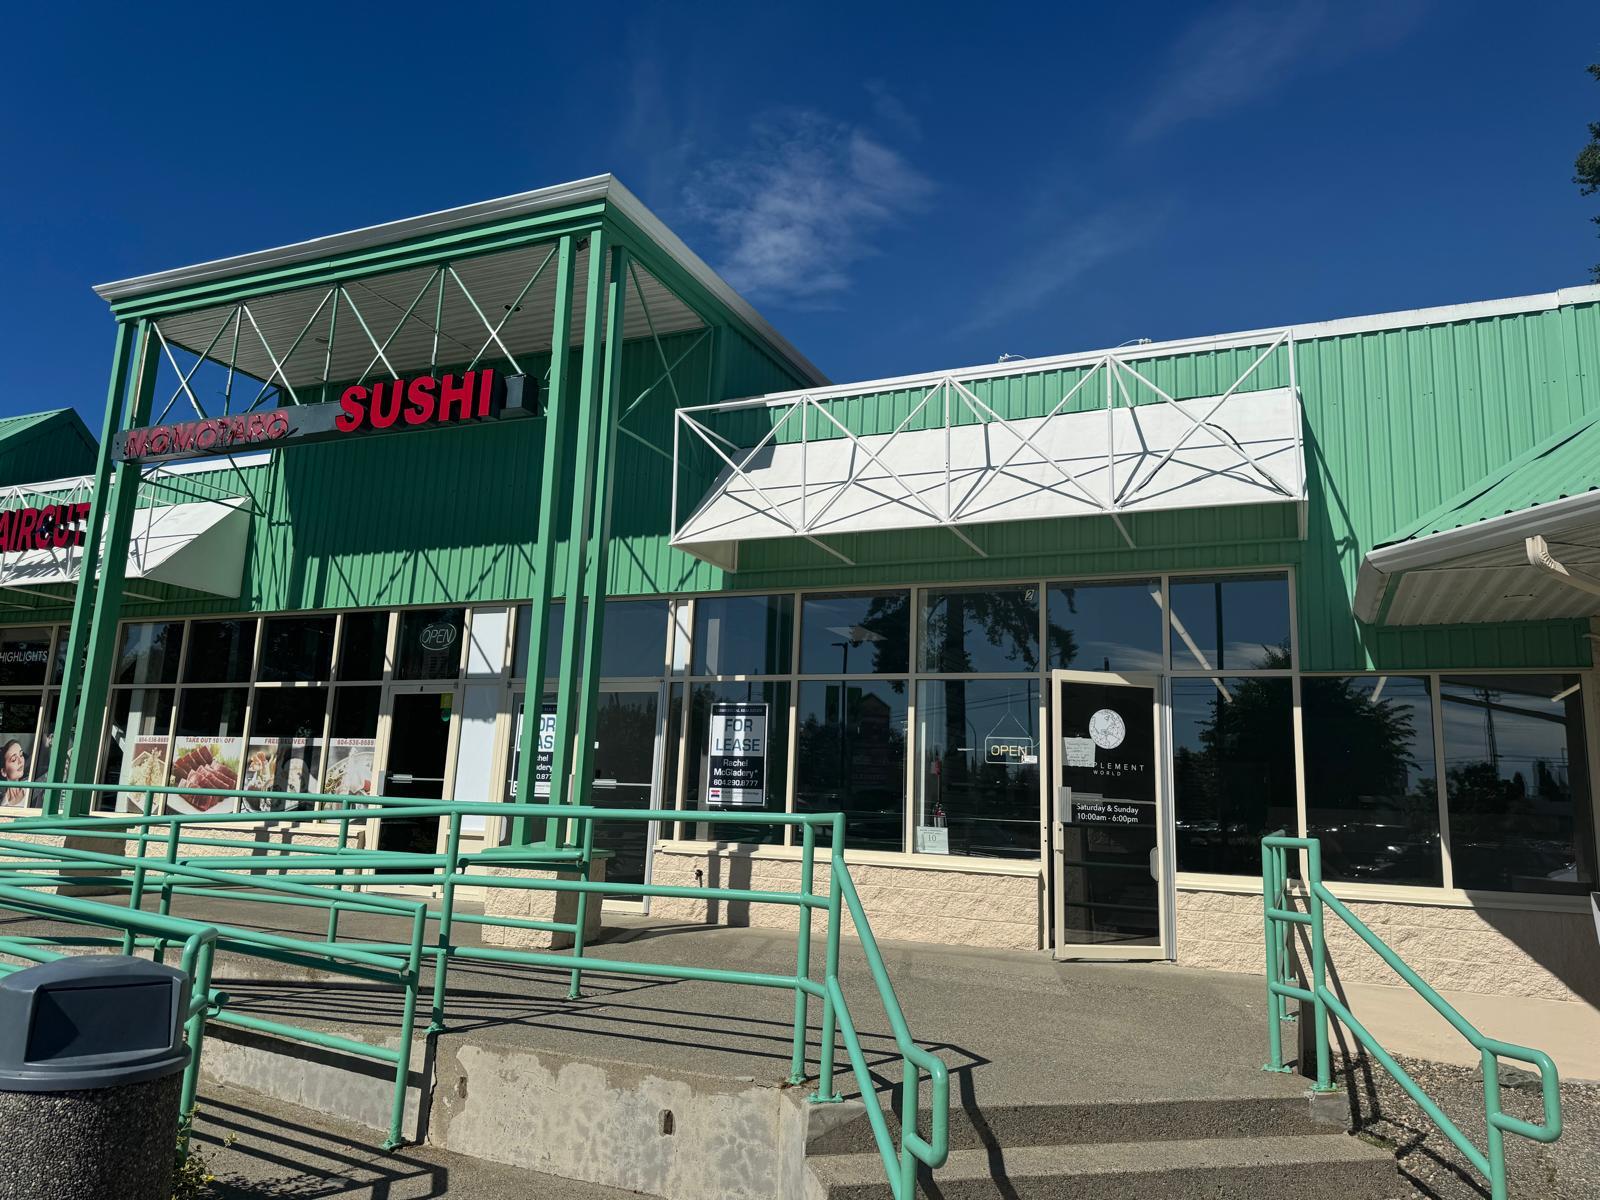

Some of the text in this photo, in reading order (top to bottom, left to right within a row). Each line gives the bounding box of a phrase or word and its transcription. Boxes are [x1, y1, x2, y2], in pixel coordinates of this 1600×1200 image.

[125, 368, 494, 458] MOMOTARO SUSHI
[421, 628, 454, 644] OPEN
[0, 650, 48, 663] HIGHLIGHTS
[725, 718, 753, 732] FOR
[716, 738, 760, 752] LEASE
[991, 744, 1028, 757] OPEN
[723, 759, 749, 767] Rachel
[1093, 769, 1121, 777] WORLD
[713, 779, 758, 787] 604.290.8777
[1076, 803, 1139, 815] Saturday & Sunday
[1077, 813, 1107, 821] 10:00am
[1112, 814, 1139, 824] 6:00pm
